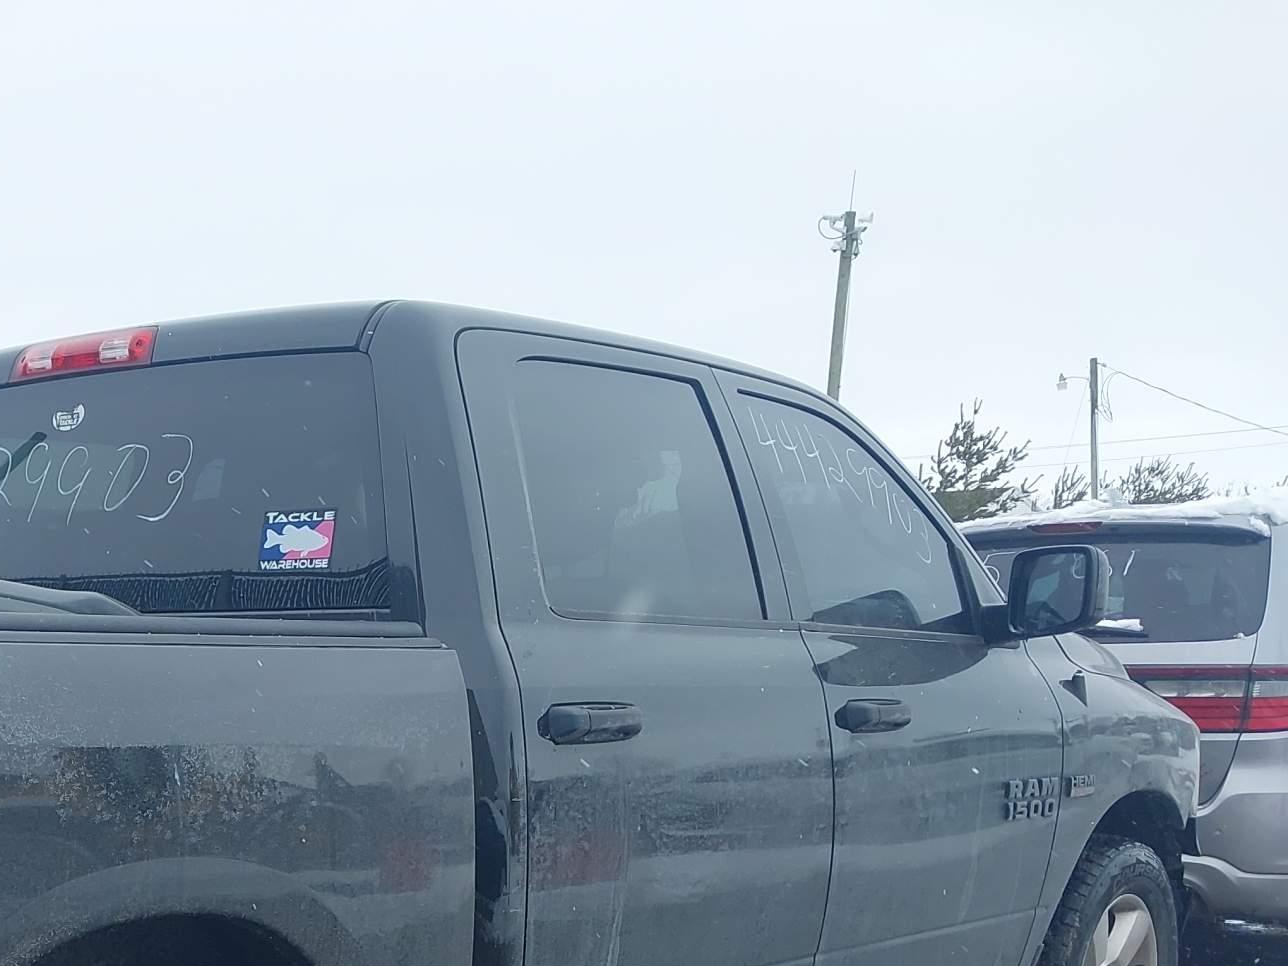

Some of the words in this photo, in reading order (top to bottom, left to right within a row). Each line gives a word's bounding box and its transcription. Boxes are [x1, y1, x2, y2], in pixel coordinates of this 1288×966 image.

[265, 510, 336, 524] TACKLE
[259, 558, 329, 570] WAREHOUSE
[1007, 776, 1058, 799] RAM
[1070, 774, 1096, 788] HEMI
[1007, 798, 1057, 821] 1500
